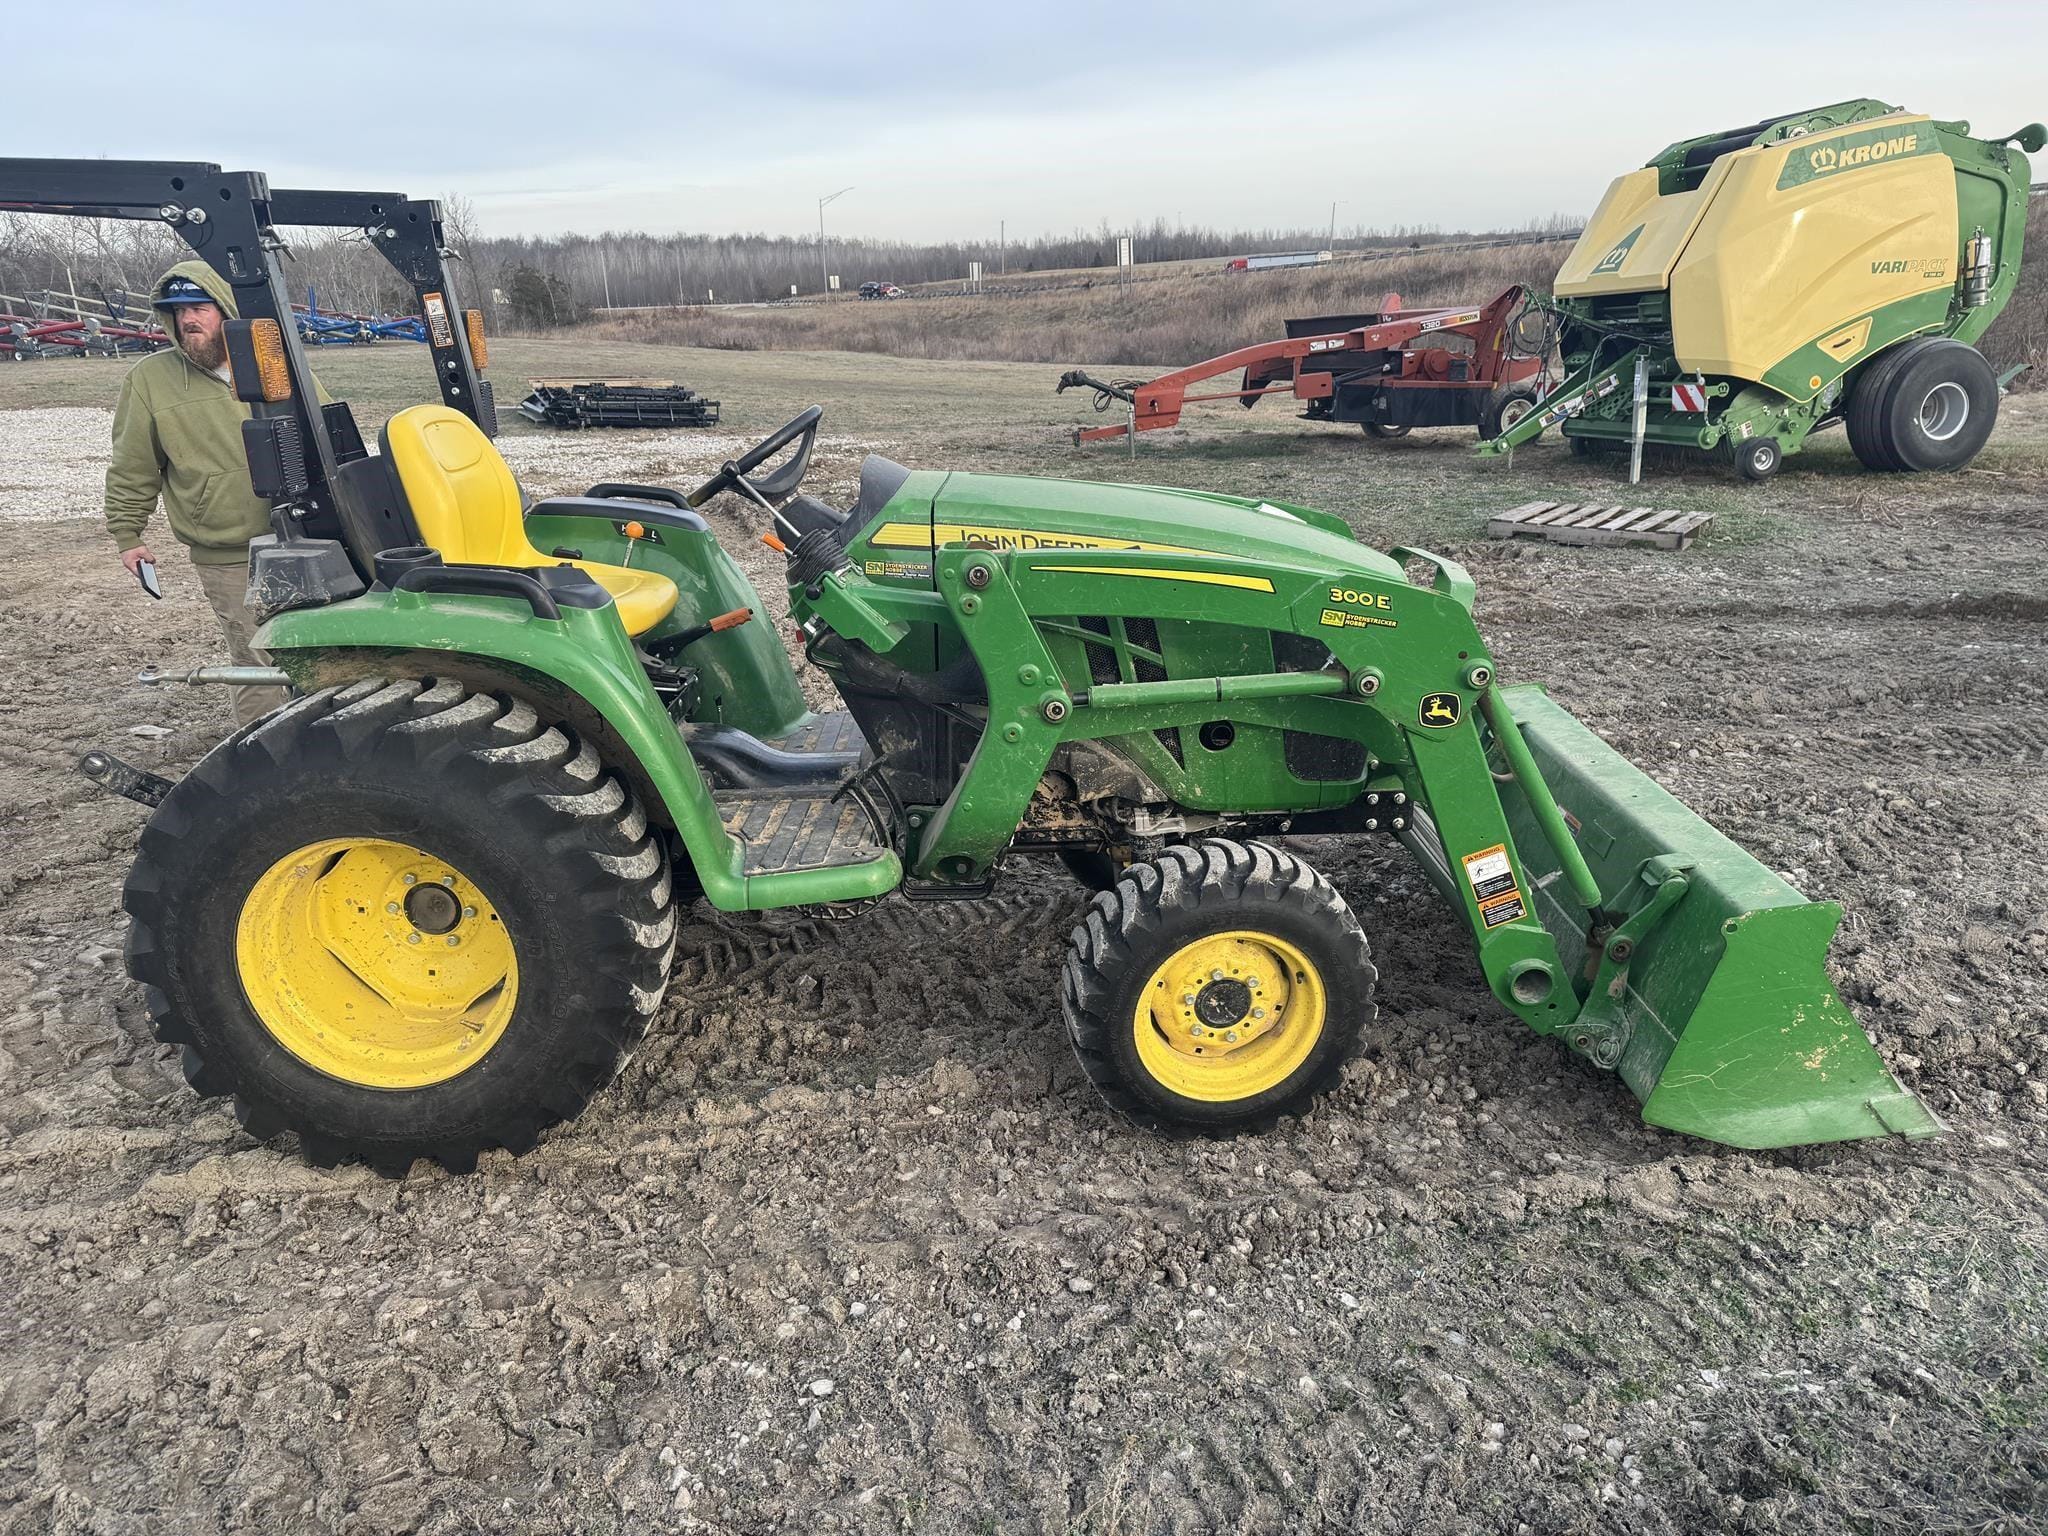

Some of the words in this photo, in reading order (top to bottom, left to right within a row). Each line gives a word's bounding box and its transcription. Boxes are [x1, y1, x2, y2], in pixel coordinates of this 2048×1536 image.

[1838, 134, 1918, 168] KRONE
[1871, 258, 1949, 274] VARIPACK
[651, 530, 657, 538] L
[866, 562, 884, 571] SN
[1324, 611, 1344, 621] SN
[1346, 614, 1397, 627] SYDENSTRICKER
[1345, 620, 1367, 628] NOBBE
[1473, 847, 1500, 858] WARNING
[1490, 894, 1517, 906] WARNING
